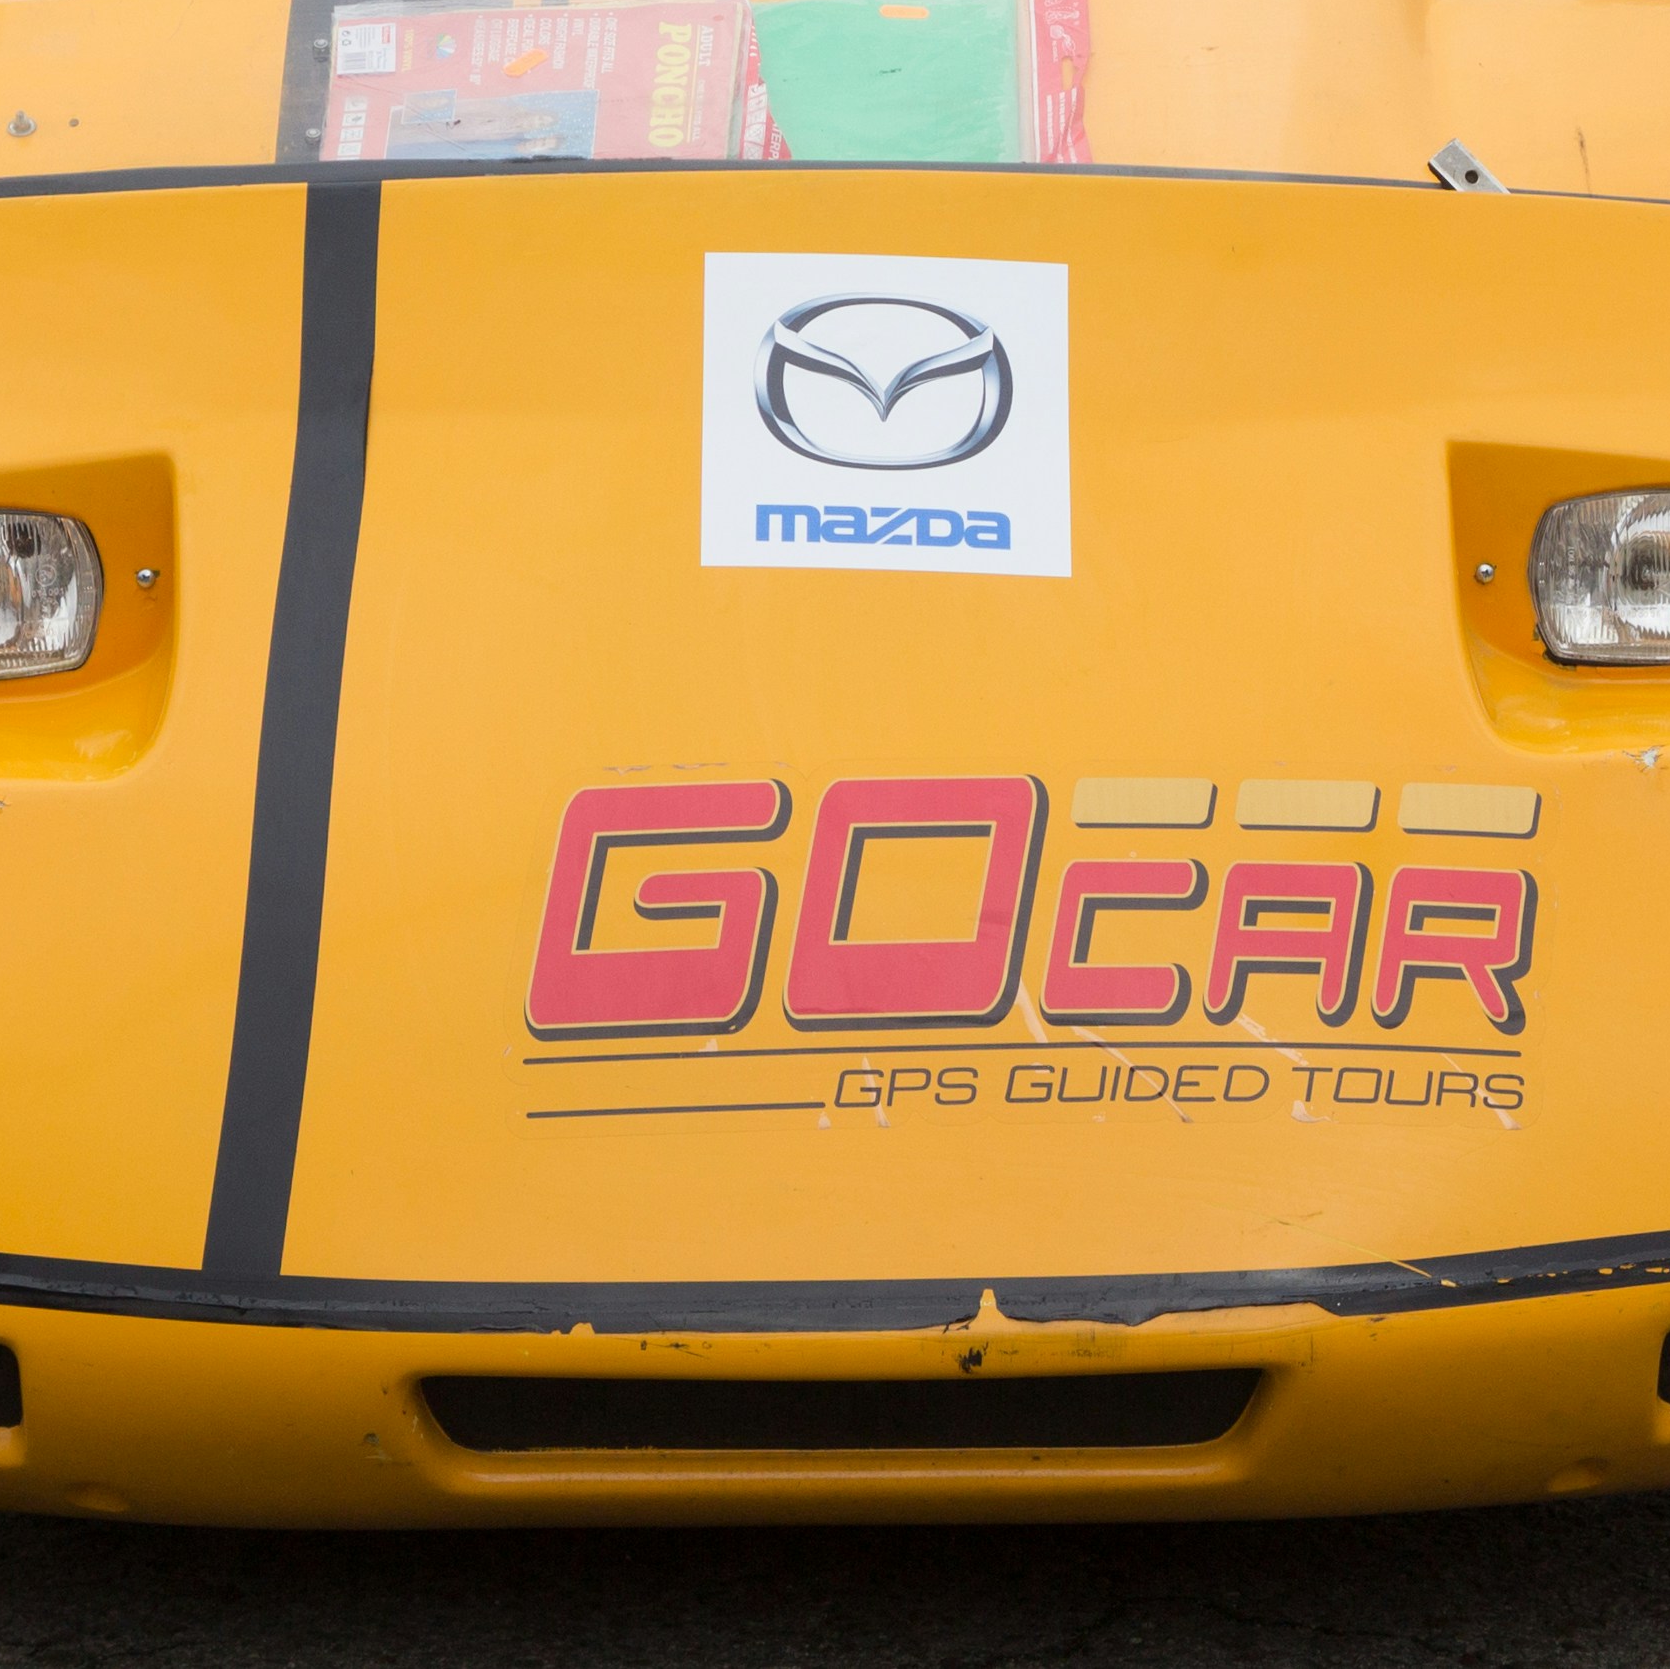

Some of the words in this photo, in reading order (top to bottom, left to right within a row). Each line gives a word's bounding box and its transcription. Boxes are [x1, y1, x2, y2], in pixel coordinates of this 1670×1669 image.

[601, 61, 613, 74] ALL
[698, 25, 715, 67] ADULT
[647, 21, 693, 148] PONCHO
[835, 1067, 979, 1111] GPS
[1002, 1063, 1272, 1107] GUIDED
[1290, 1066, 1527, 1112] TOURS
